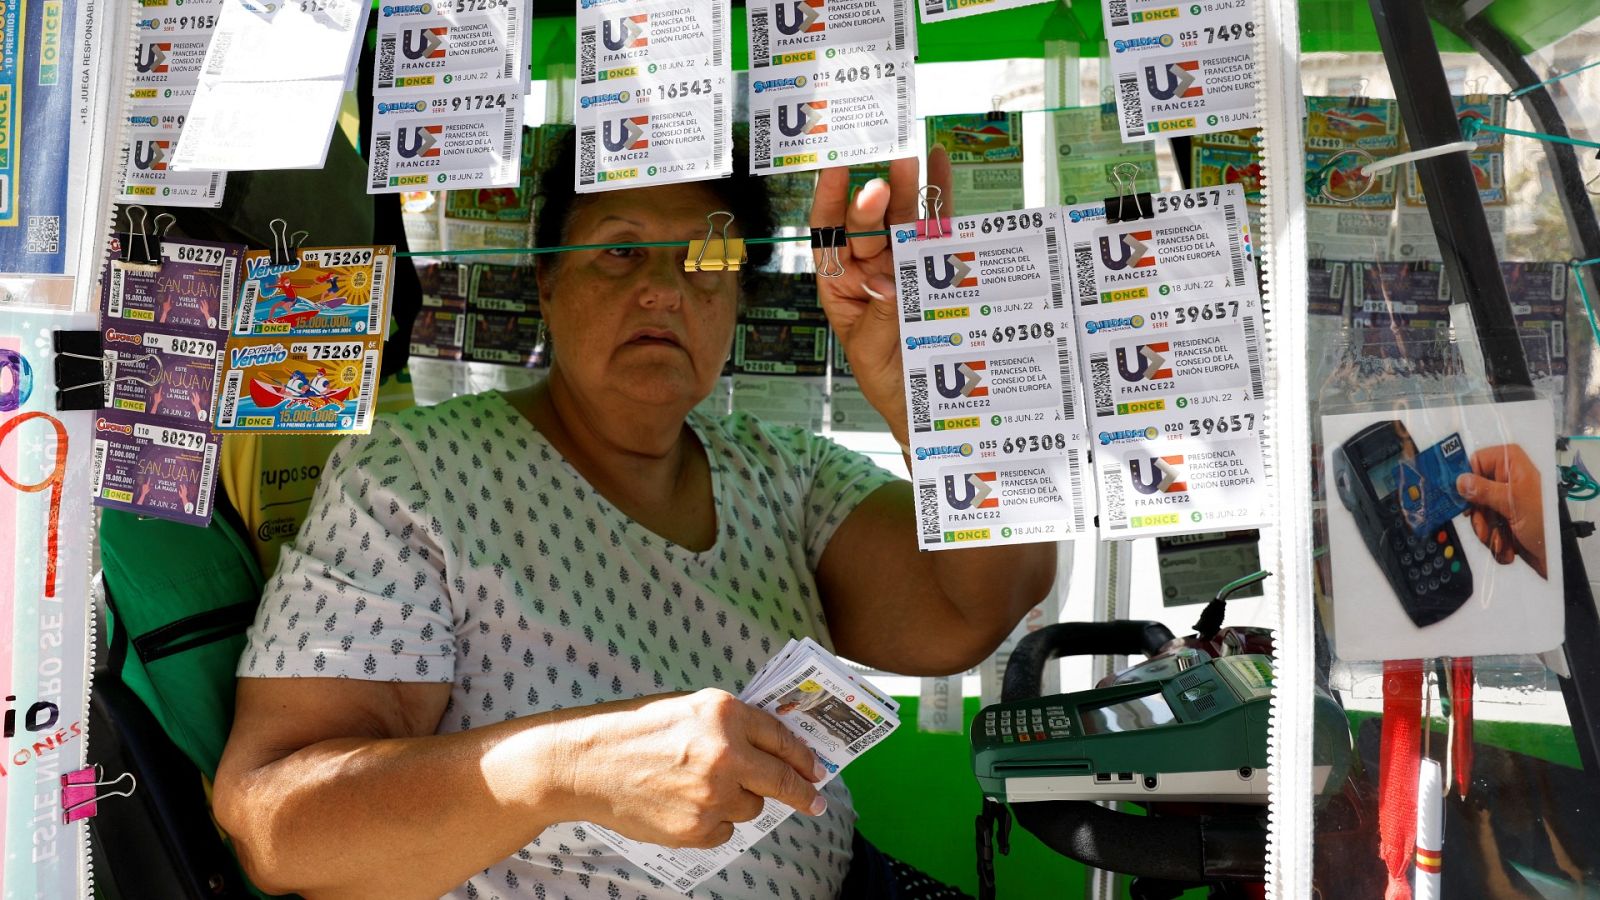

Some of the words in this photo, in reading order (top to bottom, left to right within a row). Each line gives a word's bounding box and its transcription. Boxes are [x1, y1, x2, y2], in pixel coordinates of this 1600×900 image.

[1145, 9, 1178, 20] ONCE
[180, 16, 218, 30] 9185
[6, 13, 15, 54] PREMIOS
[44, 6, 58, 60] ONCE
[83, 0, 94, 66] RESPONSABL
[1179, 29, 1199, 39] 055
[1204, 21, 1256, 44] 7498
[777, 34, 826, 46] FRANCE22
[785, 52, 814, 63] ONCE
[402, 60, 445, 70] FRANCE22
[813, 71, 831, 81] 015
[835, 62, 895, 84] 40812
[82, 69, 90, 102] JUEGA
[406, 76, 433, 85] ONCE
[636, 87, 652, 96] 010
[656, 78, 712, 100] 16543
[432, 98, 448, 106] 055
[451, 92, 506, 111] 91724
[1151, 99, 1206, 112] FRANCE22
[1161, 119, 1194, 130] ONCE
[779, 136, 828, 148] FRANCE22
[603, 152, 649, 163] FRANCE22
[786, 154, 816, 164] ONCE
[396, 160, 440, 169] FRANCE22
[400, 176, 427, 185] ONCE
[609, 169, 637, 180] ONCE
[1157, 188, 1222, 213] 39657
[958, 220, 976, 230] 053
[981, 212, 1043, 235] 69308
[178, 246, 222, 263] 80279
[979, 247, 1024, 257] PRESIDENCIA
[324, 251, 371, 266] 75269
[980, 256, 1016, 266] FRANCESA
[980, 266, 1014, 276] CONSEJO
[1104, 269, 1158, 282] FRANCE22
[982, 275, 1006, 285] UNIÓN
[1008, 272, 1041, 282] EUROPEA
[182, 280, 219, 298] JUAN
[1114, 289, 1146, 300] ONCE
[928, 290, 980, 301] FRANCE22
[937, 308, 968, 319] ONCE
[1003, 303, 1022, 312] JUN.
[1150, 310, 1170, 320] 019
[1175, 300, 1240, 325] 39657
[132, 310, 153, 319] ONCE
[969, 329, 987, 339] 054
[992, 322, 1055, 344] 69308
[171, 339, 214, 356] 80279
[1173, 336, 1220, 348] PRESIDENCIA
[313, 345, 361, 359] 75269
[1174, 347, 1213, 357] FRANCESA
[232, 350, 286, 368] Verano
[1175, 357, 1211, 367] CONSEJO
[1177, 366, 1203, 376] UNIÓN
[1204, 362, 1240, 374] EUROPEA
[1121, 381, 1175, 394] FRANCE22
[1201, 395, 1221, 404] JUN.
[1222, 393, 1232, 401] 22
[123, 401, 144, 410] ONCE
[938, 400, 990, 410] FRANCE22
[1131, 401, 1163, 412] ONCE
[947, 418, 978, 428] ONCE
[1165, 423, 1185, 433] 020
[1190, 414, 1256, 438] 39657
[162, 430, 203, 449] 80279
[979, 440, 998, 450] 055
[1003, 433, 1066, 455] 69308
[1443, 440, 1460, 455] VISA
[138, 459, 161, 476] SAN
[162, 464, 199, 483] JUAN
[111, 492, 131, 500] ONCE
[1135, 495, 1190, 507] FRANCE22
[948, 511, 1001, 522] FRANCE22
[957, 530, 988, 540] ONCE
[857, 703, 877, 720] ONCE
[0, 720, 82, 777] ONES
